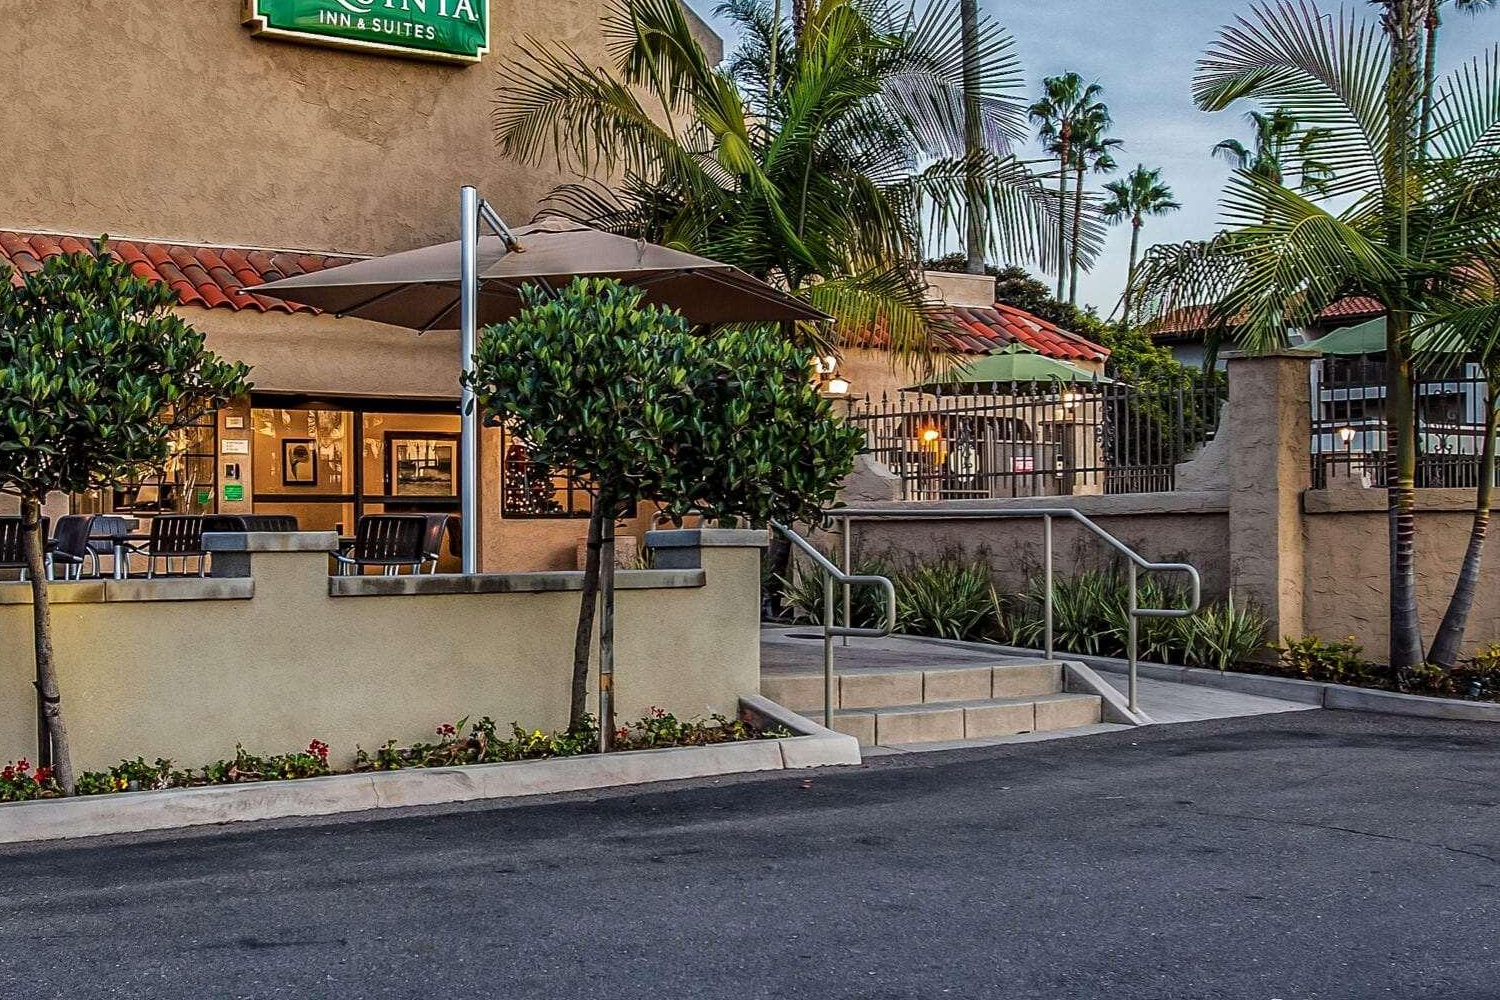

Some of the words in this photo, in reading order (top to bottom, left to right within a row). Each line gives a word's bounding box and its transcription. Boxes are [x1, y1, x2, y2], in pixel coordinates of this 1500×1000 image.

[319, 10, 351, 28] INN
[357, 18, 366, 30] &
[372, 18, 435, 40] SUITES
